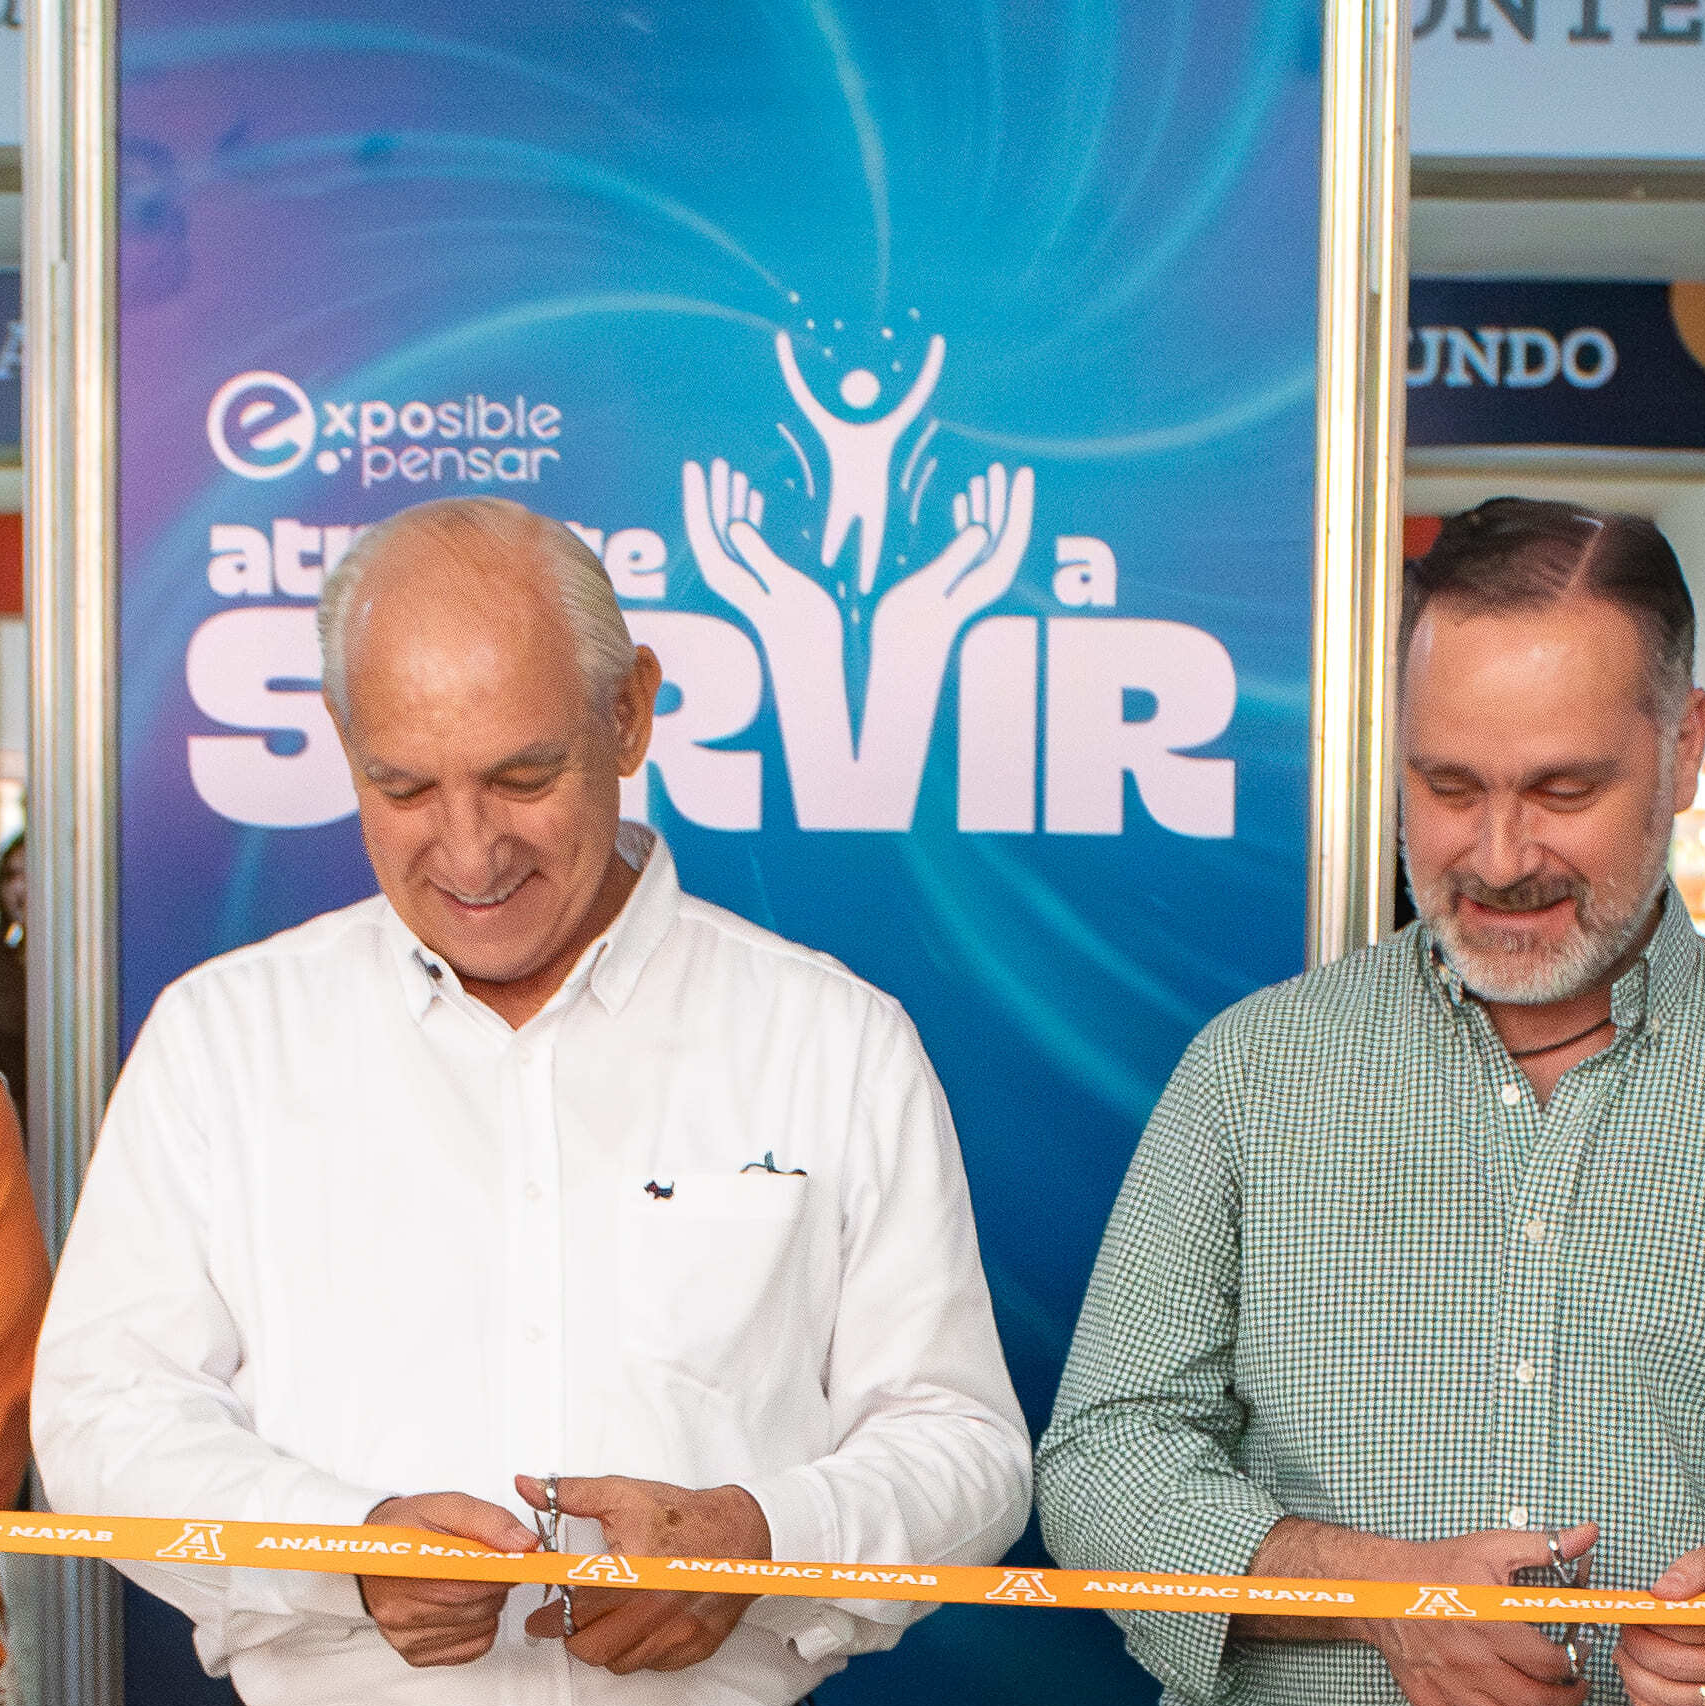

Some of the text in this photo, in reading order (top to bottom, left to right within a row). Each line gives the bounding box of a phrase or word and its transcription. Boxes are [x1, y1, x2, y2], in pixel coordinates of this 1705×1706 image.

[361, 445, 561, 488] pensar
[1053, 535, 1118, 607] a
[186, 607, 1238, 840] SRVIR
[156, 1522, 227, 1561] A
[831, 1568, 938, 1586] MAYAB
[984, 1570, 1057, 1603] A
[1247, 1588, 1355, 1604] MAYAB
[1405, 1586, 1477, 1617] A
